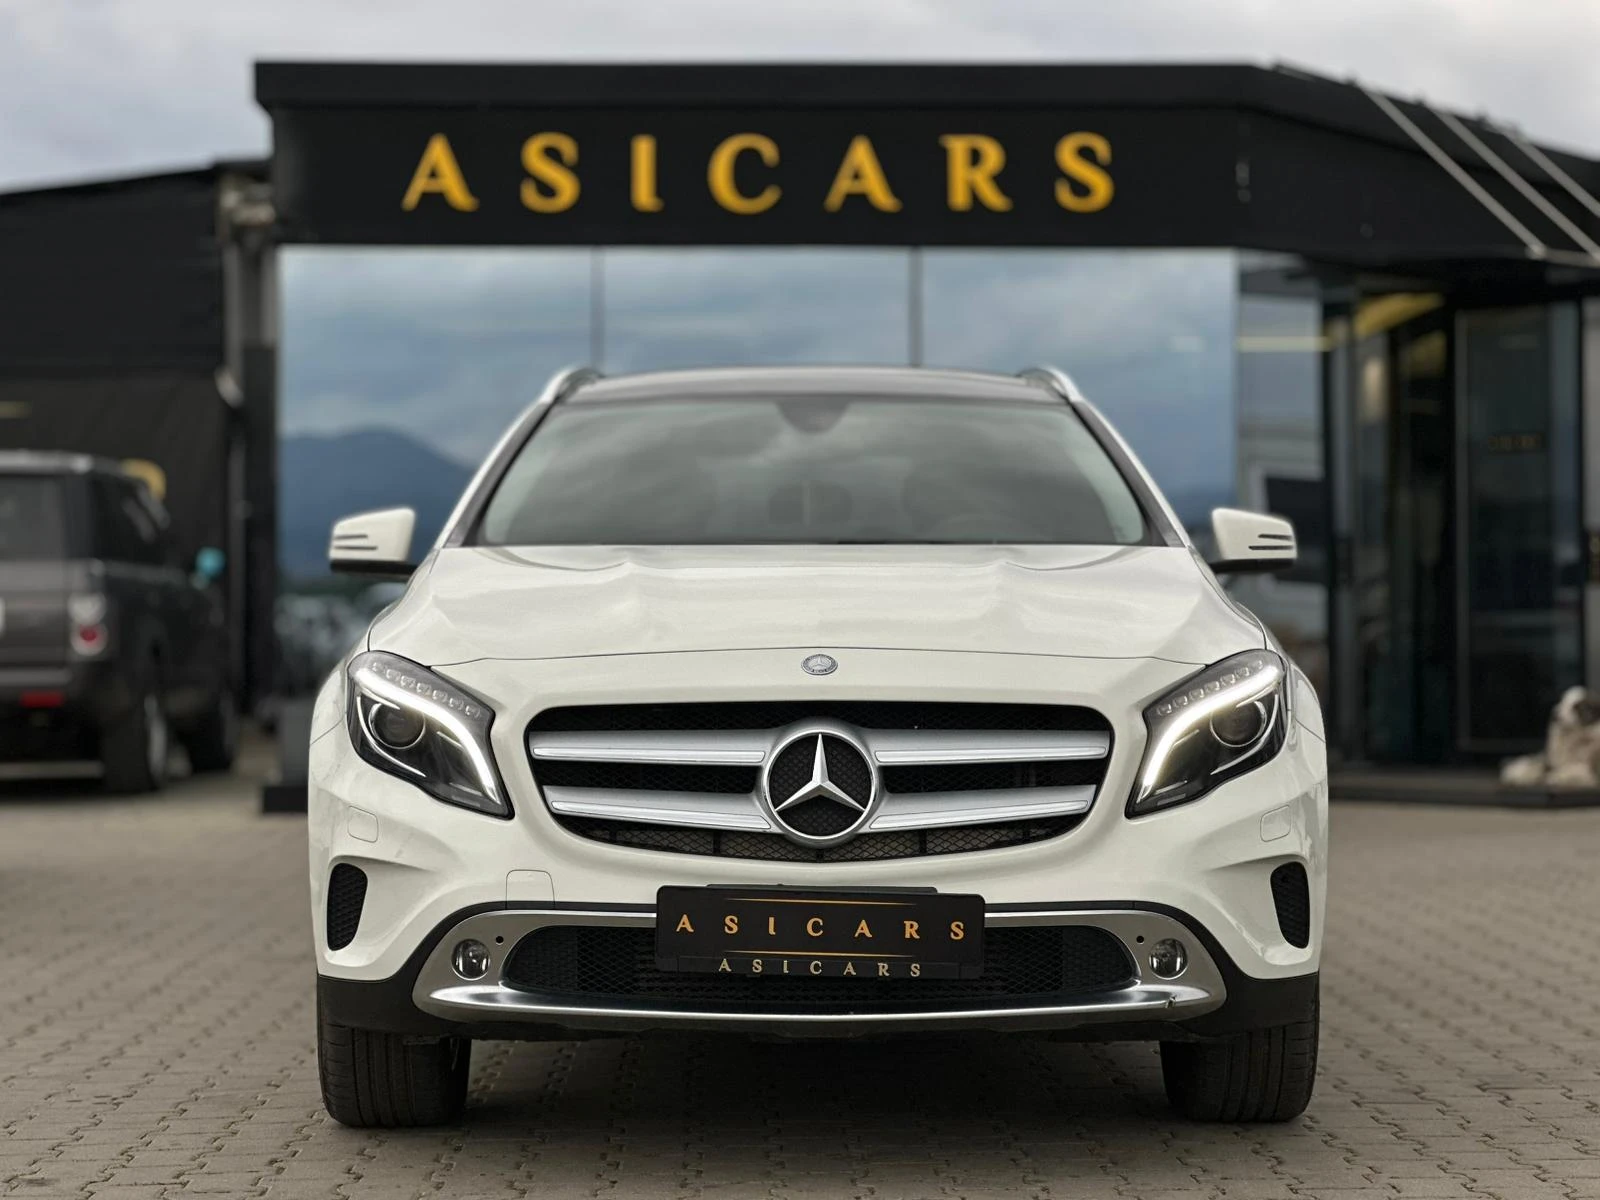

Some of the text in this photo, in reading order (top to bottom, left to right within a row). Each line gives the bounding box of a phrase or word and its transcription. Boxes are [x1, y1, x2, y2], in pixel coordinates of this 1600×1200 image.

[403, 132, 1113, 213] ASICARS
[676, 914, 965, 940] ASICARS
[718, 958, 921, 977] ASICARS
